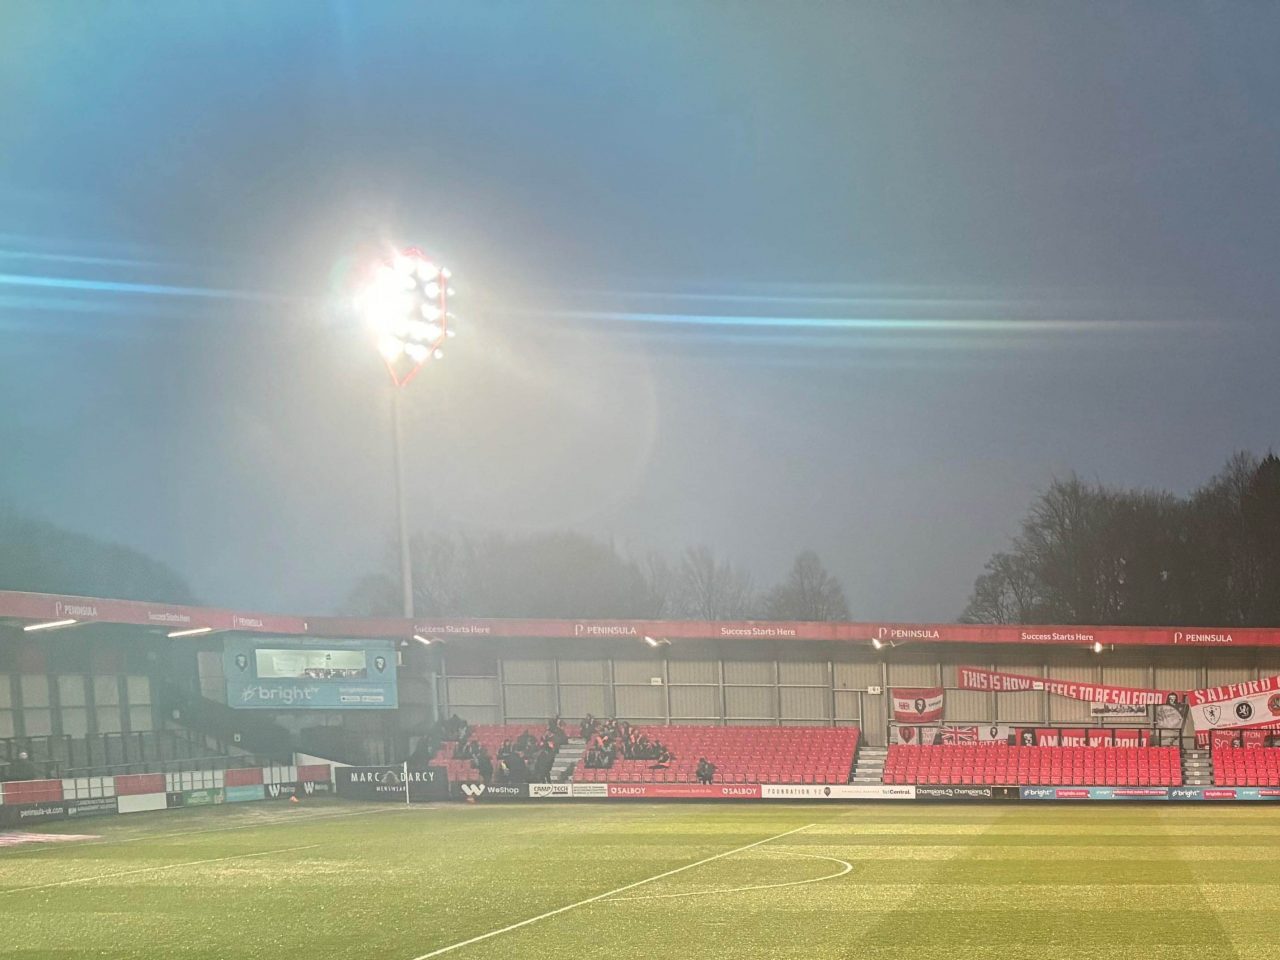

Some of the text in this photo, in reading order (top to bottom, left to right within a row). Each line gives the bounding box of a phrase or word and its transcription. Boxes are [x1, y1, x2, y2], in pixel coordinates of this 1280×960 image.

[587, 626, 636, 634] PENINSULA
[721, 628, 796, 636] Success Starts Here
[891, 629, 939, 638] PENINSULA
[1021, 632, 1094, 641] Success Starts Here
[1186, 634, 1232, 642] PENINSULA
[962, 670, 1162, 705] THIS IS HOW FEELS TO BE SALFORD
[1194, 678, 1271, 704] SALFORD
[259, 686, 310, 704] bright
[351, 772, 434, 782] MARC DARCY
[488, 786, 520, 794] WeShop
[1030, 789, 1050, 797] bright
[1178, 790, 1198, 798] bright
